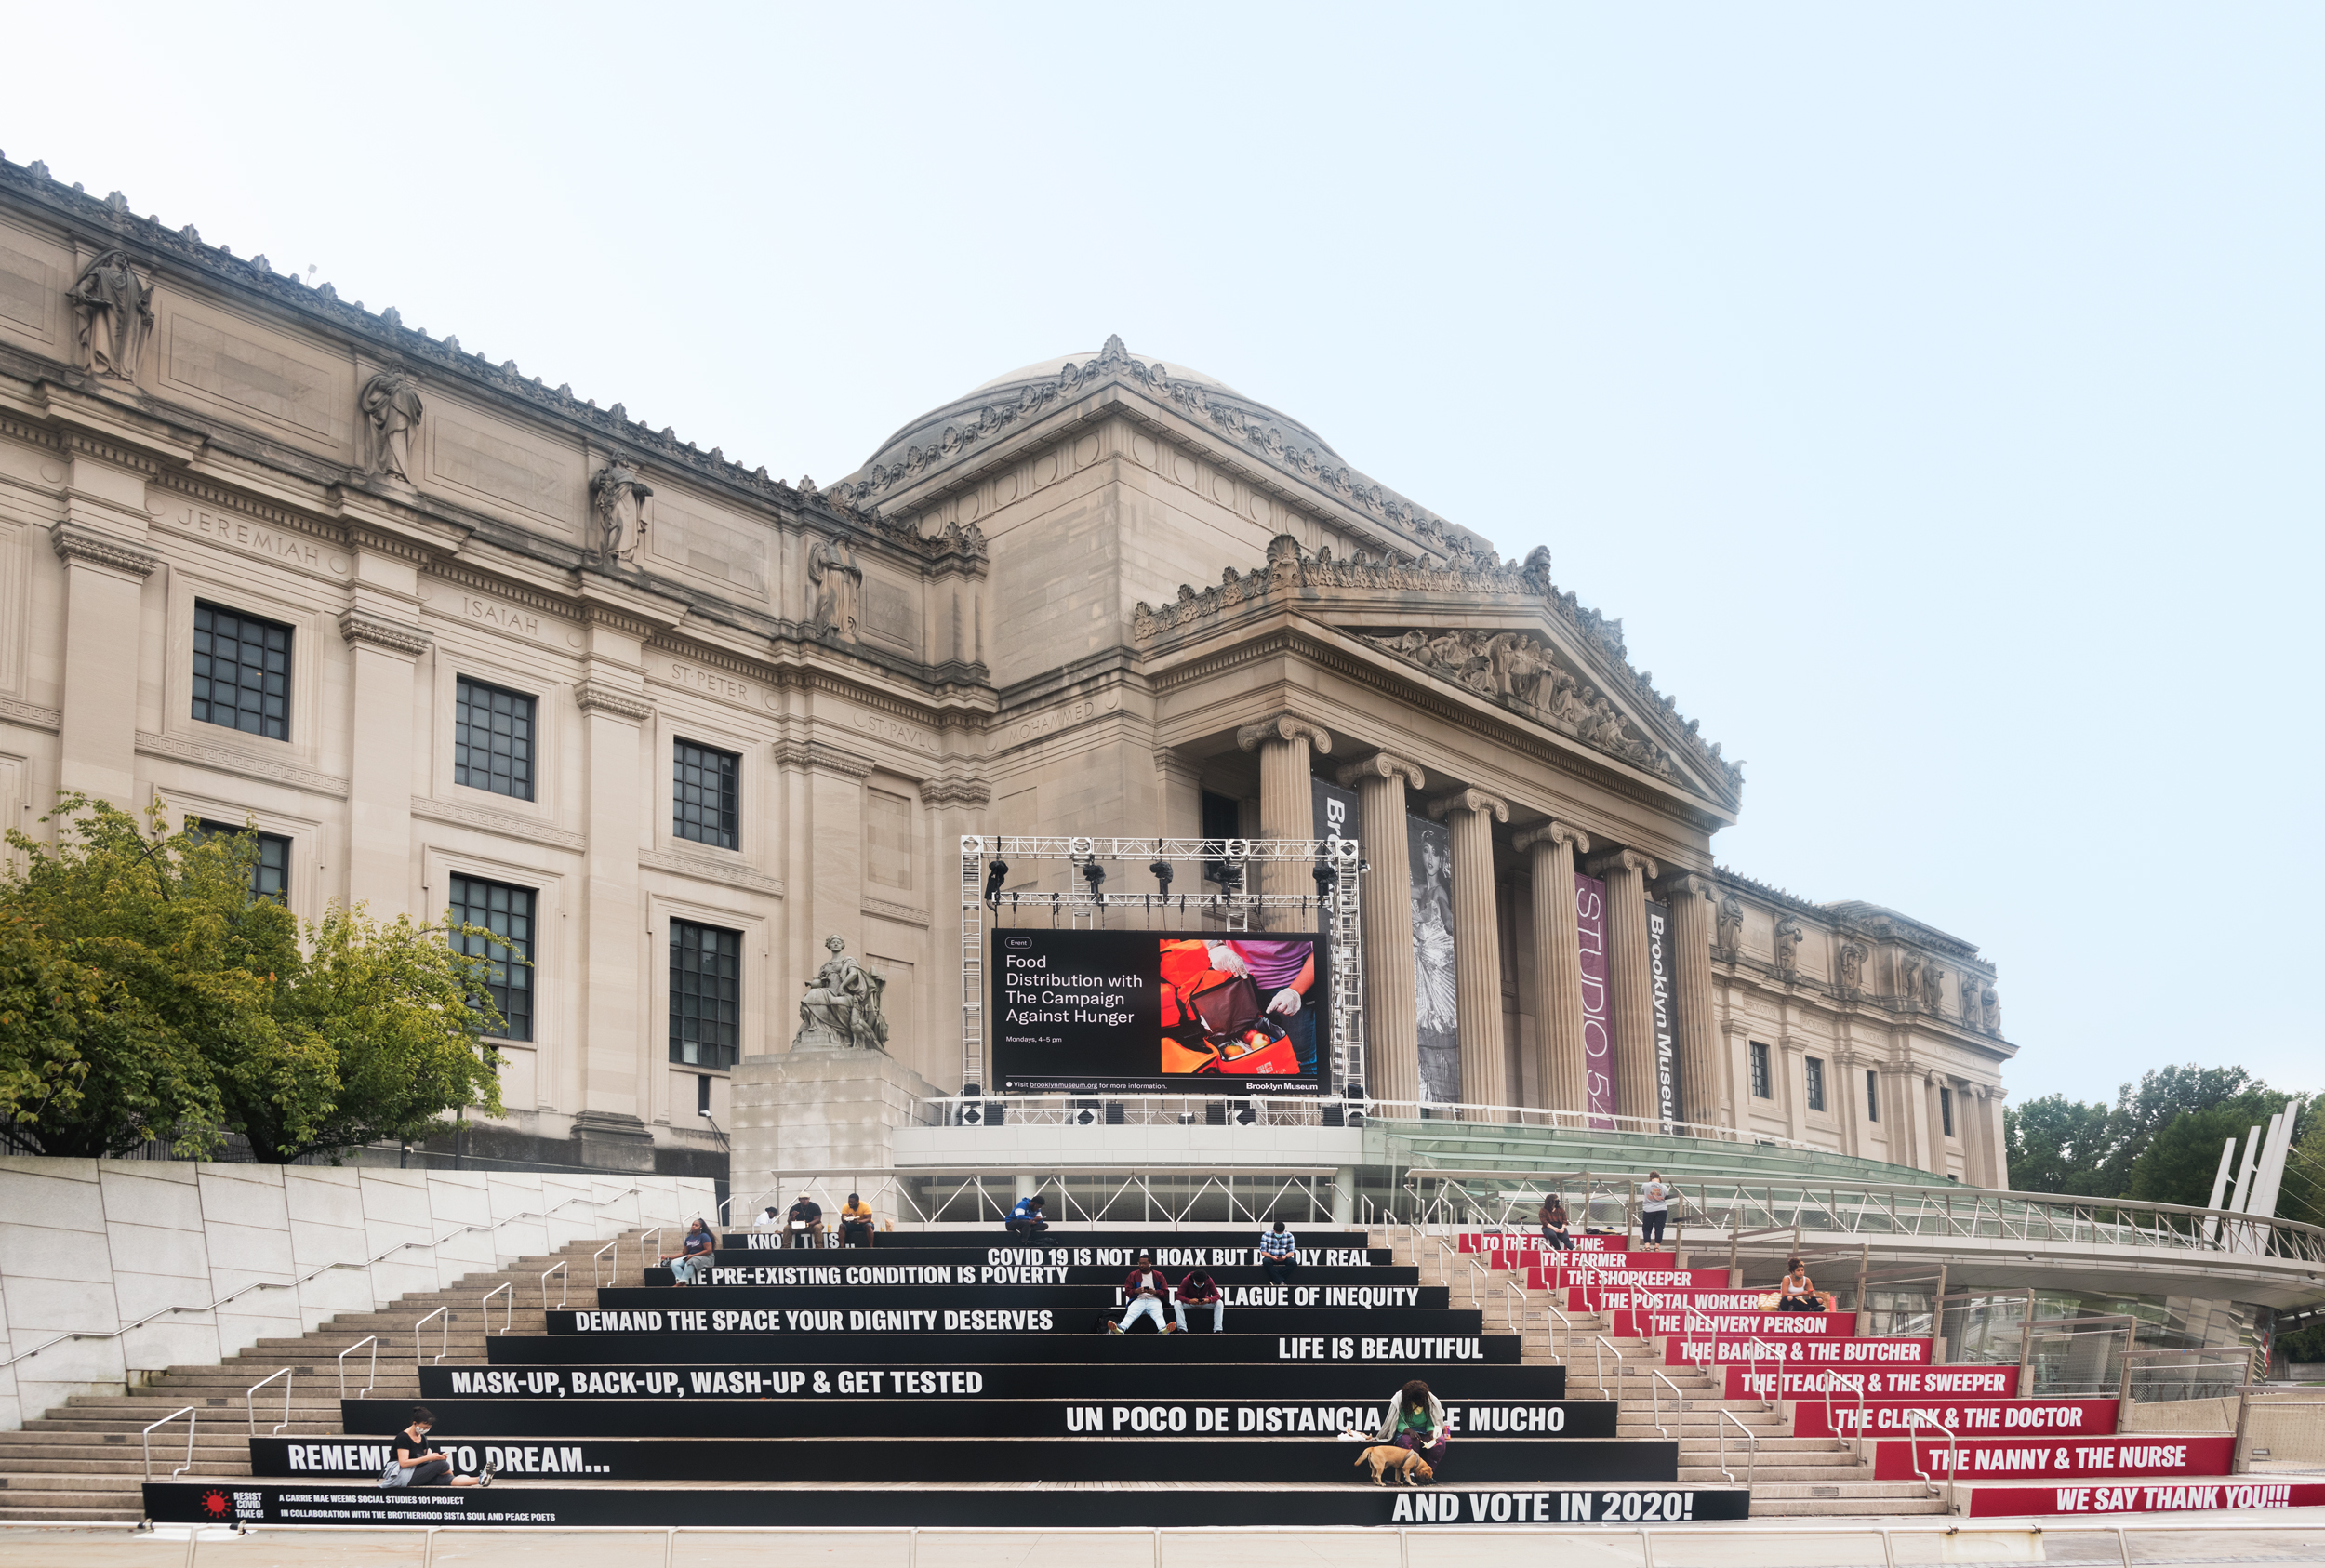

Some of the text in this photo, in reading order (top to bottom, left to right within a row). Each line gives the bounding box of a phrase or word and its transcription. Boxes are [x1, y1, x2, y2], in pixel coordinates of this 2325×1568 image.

[177, 508, 319, 566] JEREMIAH
[463, 597, 538, 636] ISAIAH
[697, 671, 748, 700] PETER
[1008, 702, 1094, 744] MOHAMMED
[1006, 955, 1046, 968] Food
[1651, 913, 1667, 1028] Brooklyn
[1006, 973, 1143, 988] Distribution with
[1005, 990, 1124, 1008] The Campaign
[1576, 887, 1611, 1123] STUDIO 54
[1006, 1009, 1135, 1027] Against Hunger
[1246, 1082, 1282, 1091] Brooklyn
[1483, 1237, 1499, 1250] TO
[1503, 1237, 1527, 1251] THE
[989, 1249, 1043, 1265] COVID
[1049, 1249, 1068, 1266] 19
[1074, 1249, 1091, 1265] IS
[1097, 1249, 1133, 1266] NOT
[1157, 1249, 1206, 1266] HOAX
[1213, 1249, 1247, 1266] BUT
[1327, 1250, 1370, 1266] REAL
[1542, 1253, 1626, 1268] THE FARMER
[712, 1267, 841, 1284] PRE-EXISTING
[846, 1267, 950, 1284] CONDITION
[958, 1267, 975, 1283] IS
[982, 1267, 1068, 1283] POVERTY
[1567, 1270, 1691, 1286] THE SHOPKEEPER
[1295, 1287, 1319, 1305] OF
[1326, 1285, 1418, 1309] INEQUITY
[1600, 1293, 1628, 1309] THE
[1631, 1293, 1692, 1309] POSTAL
[576, 1310, 1052, 1330] DEMAND THE SPACE YOUR DIGNITY DESERVES
[1649, 1315, 1827, 1333] THE DELIVERY PERSON
[1280, 1338, 1482, 1359] LIFE IS BEAUTIFUL
[1681, 1342, 1920, 1361] THE BARBER & THE BUTCHER
[452, 1371, 982, 1397] MASK-UP, BACK-UP, WASH-UP & GET TESTED
[1742, 1374, 2005, 1392] THE TEACHER & THE SWEEPER
[1067, 1408, 1102, 1431] UN
[1113, 1407, 1186, 1431] POCO
[1196, 1408, 1229, 1430] DE
[1238, 1407, 1381, 1431] DISTANCIA
[1470, 1407, 1564, 1431] MUCHO
[1836, 1407, 2082, 1428] THE CLERK & THE DOCTOR
[440, 1446, 477, 1471] TO
[482, 1447, 609, 1474] DREAM...
[1929, 1445, 2186, 1471] THE NANNY & THE NURSE
[279, 1494, 464, 1505] A CARRIE MAE WEEMS SOCIAL STUDIES 101 PROJECT
[1392, 1490, 1695, 1523] AND VOTE IN 2020!
[2056, 1485, 2290, 1511] WE SAY THANK YOU!!!
[235, 1509, 255, 1518] TAKE
[281, 1509, 555, 1521] IN COLLABORATION WITH THE BROTHERHOOD SISTA SOUL AND PEACE POETS
